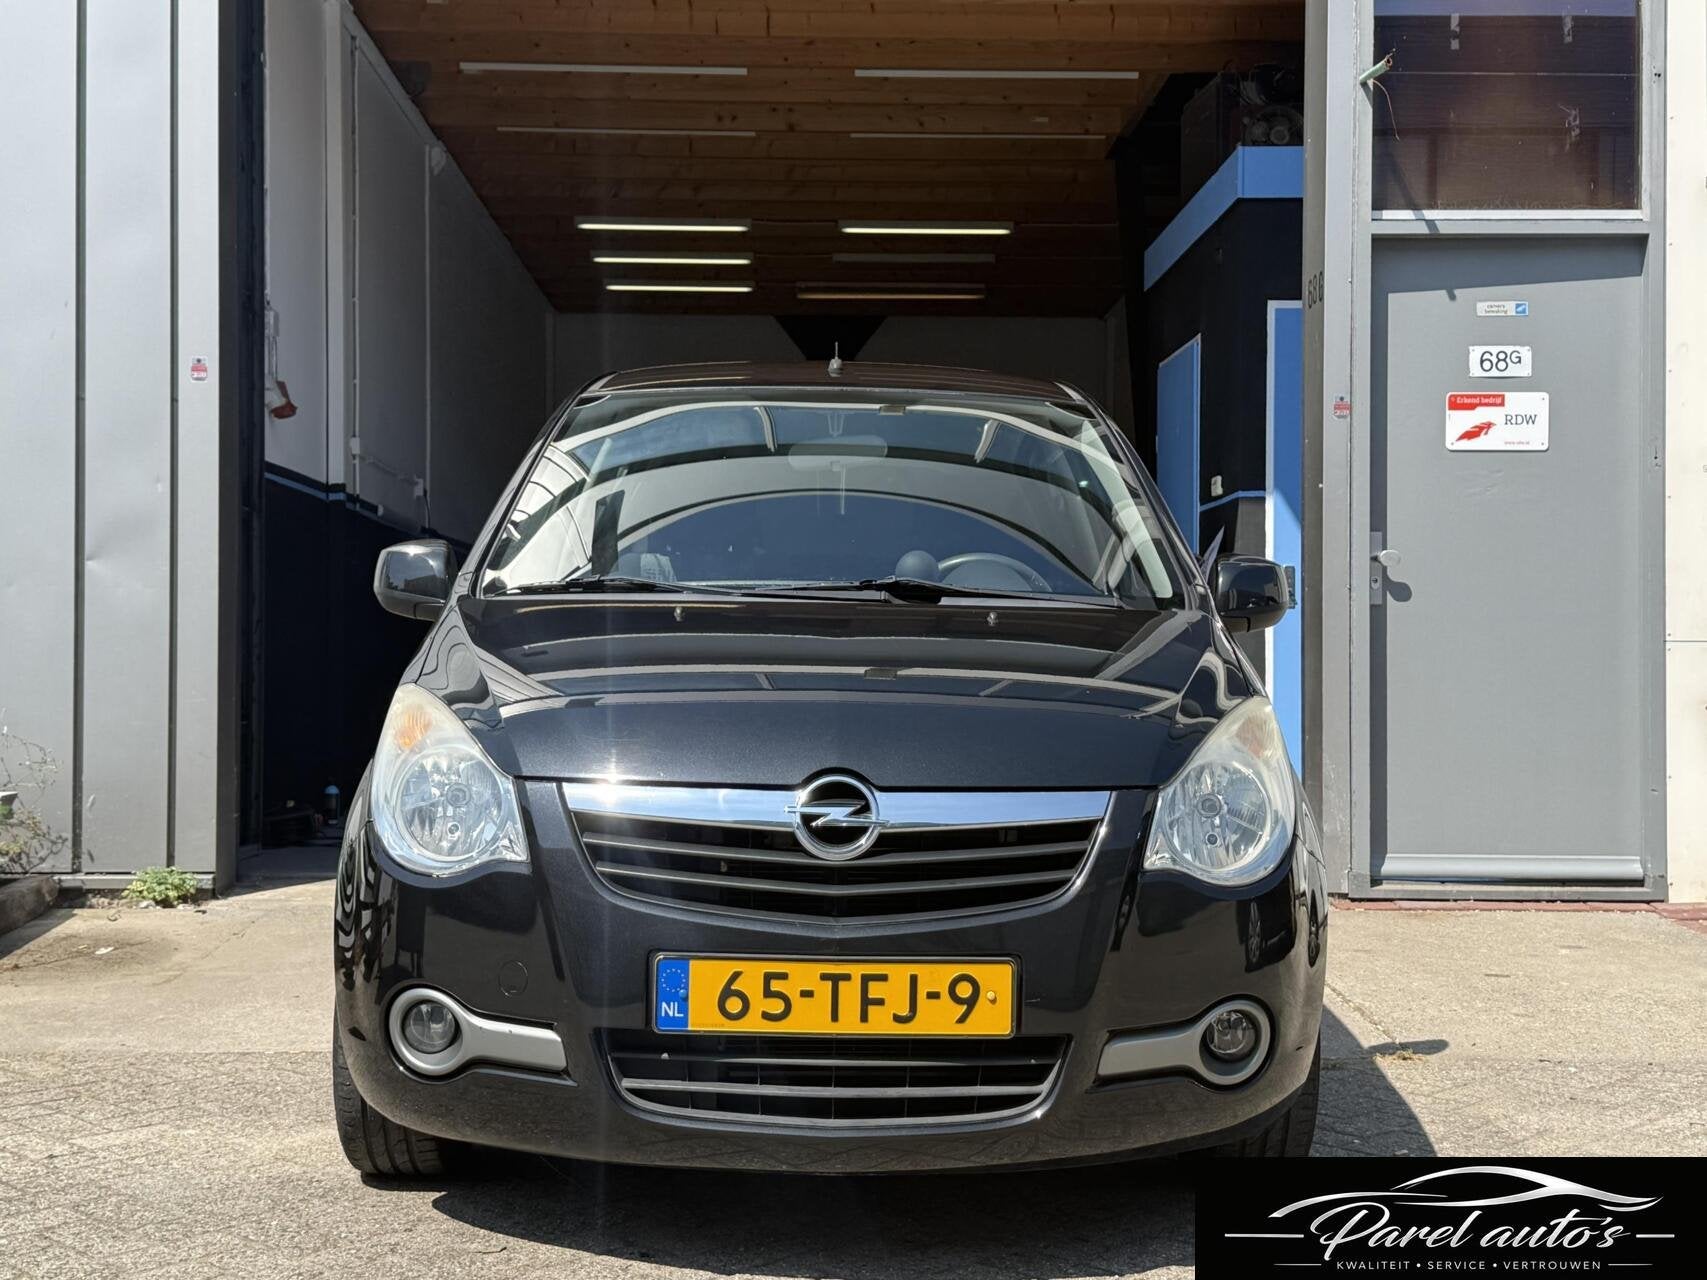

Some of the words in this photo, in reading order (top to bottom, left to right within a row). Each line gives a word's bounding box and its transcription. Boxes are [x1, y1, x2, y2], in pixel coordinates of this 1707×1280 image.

[1479, 350, 1522, 372] 68G
[1504, 414, 1537, 426] RDW
[716, 969, 981, 1024] 65-TFJ-9
[660, 1001, 684, 1018] NL
